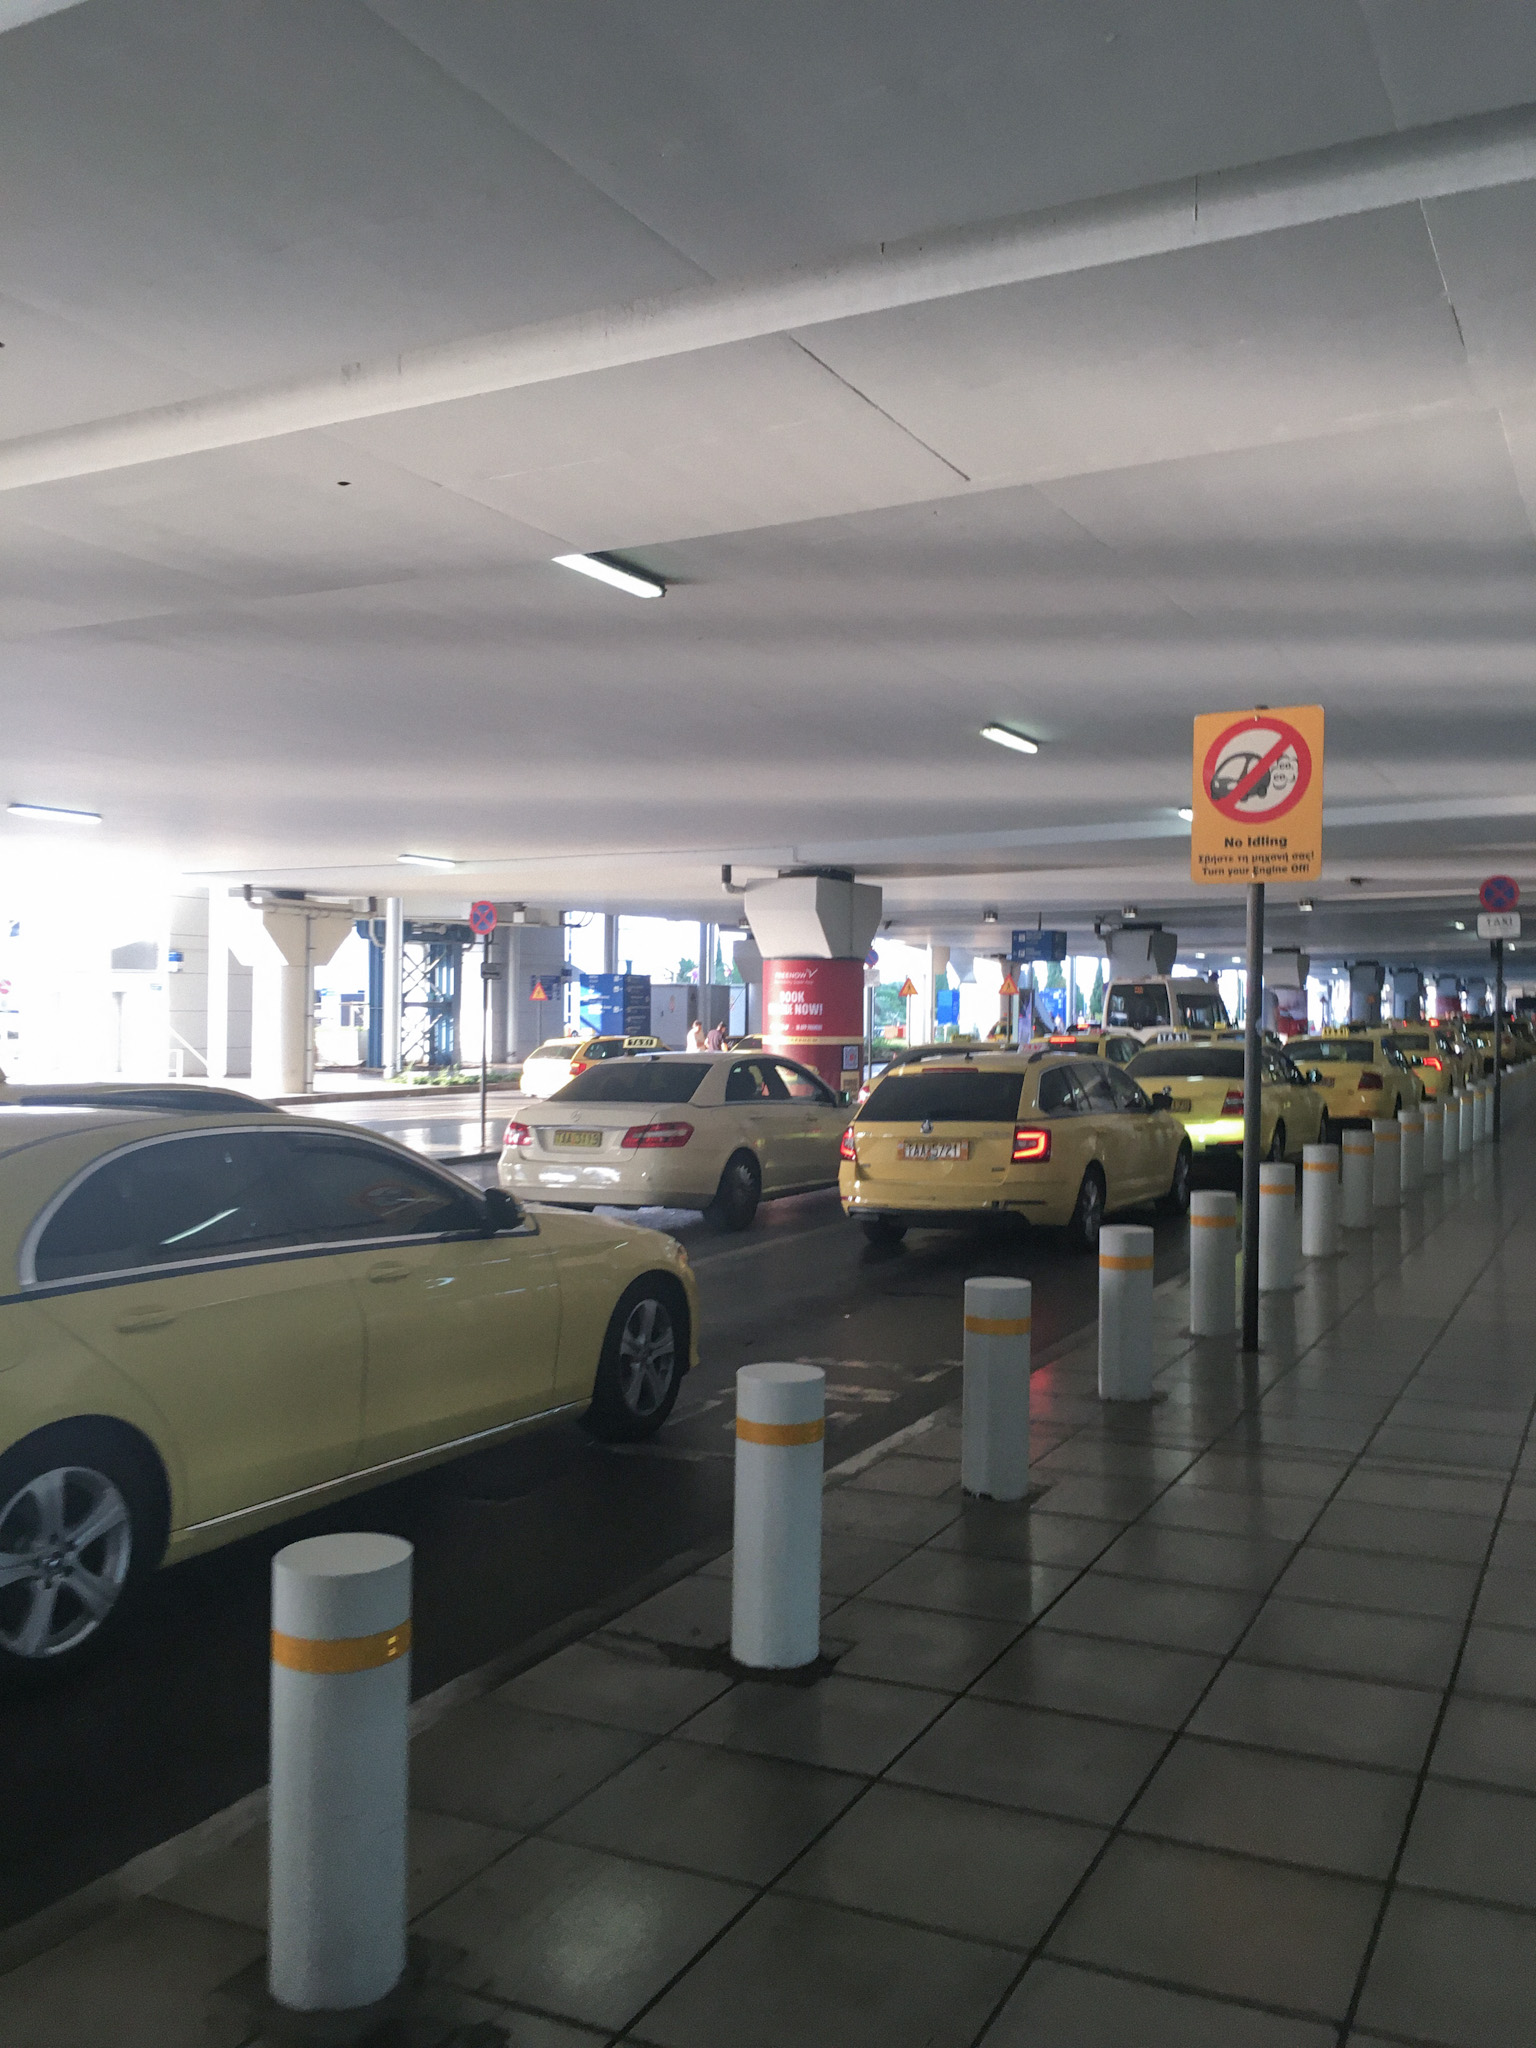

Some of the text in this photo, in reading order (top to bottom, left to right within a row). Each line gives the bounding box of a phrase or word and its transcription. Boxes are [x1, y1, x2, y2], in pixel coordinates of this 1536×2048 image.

[1225, 834, 1288, 848] No Idling
[1203, 867, 1225, 876] Turn
[1228, 867, 1249, 878] your
[1253, 865, 1288, 876] Engine
[794, 1003, 824, 1016] NOW!
